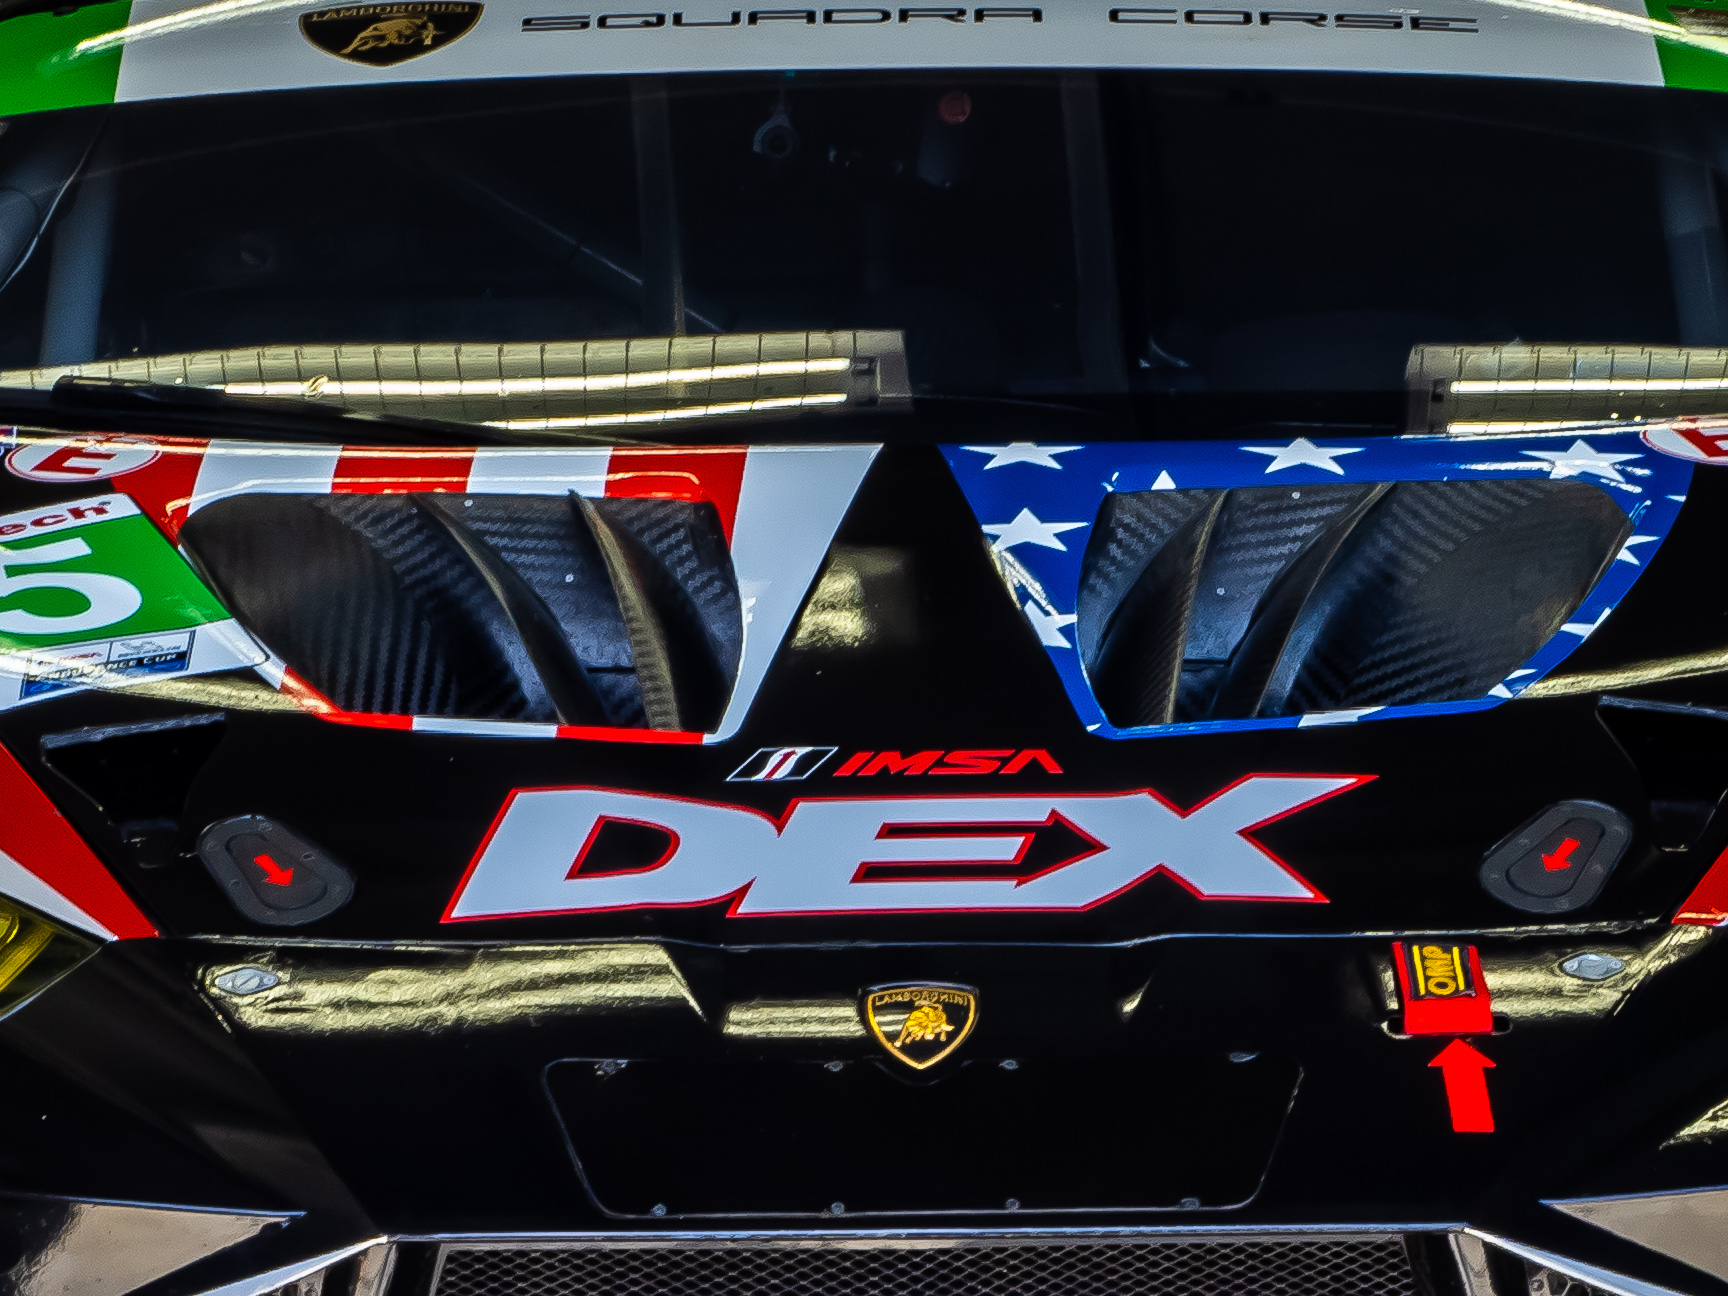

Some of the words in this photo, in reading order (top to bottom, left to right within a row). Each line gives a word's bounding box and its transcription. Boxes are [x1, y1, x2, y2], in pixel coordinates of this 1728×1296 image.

[311, 2, 471, 22] LAMBORGHINI
[521, 7, 1044, 33] SQUADRA
[1108, 7, 1480, 33] CORSE
[30, 444, 119, 475] E
[832, 748, 1064, 777] IMSA
[441, 773, 1378, 923] DEX
[1422, 945, 1457, 996] OMP
[874, 989, 969, 1007] LAMBORGHINI
